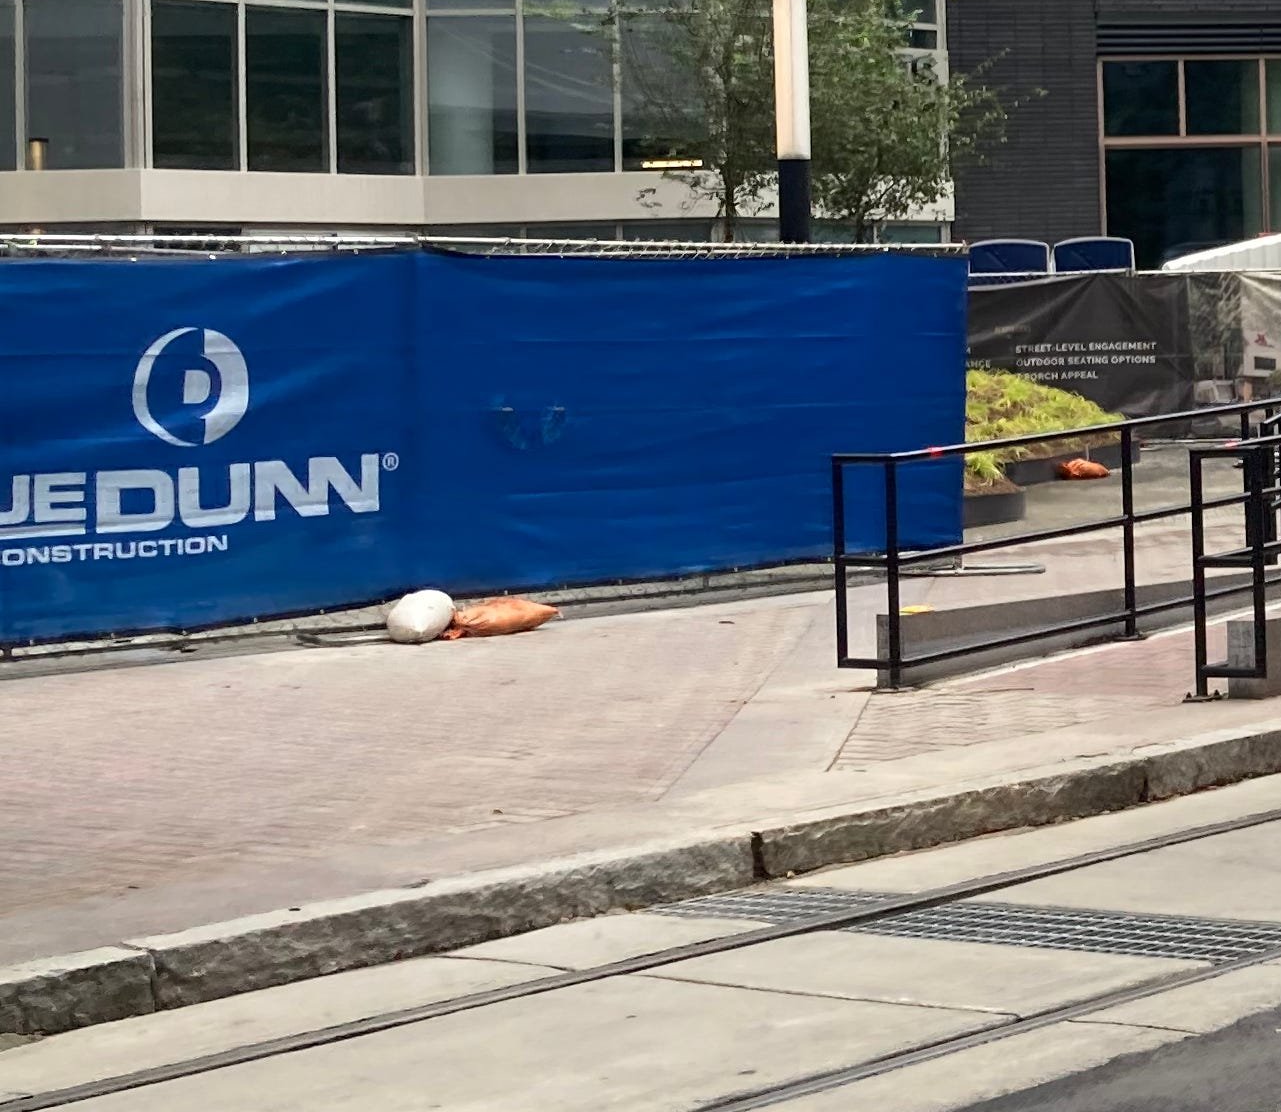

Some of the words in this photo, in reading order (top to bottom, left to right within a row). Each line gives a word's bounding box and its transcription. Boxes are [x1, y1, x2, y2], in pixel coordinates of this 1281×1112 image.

[1088, 341, 1157, 352] ENGAGEMENT
[1016, 357, 1065, 367] OUTDOOR
[1067, 356, 1109, 366] SEATING
[1110, 354, 1156, 365] OPTIONS
[1060, 370, 1099, 381] APPEAL
[0, 534, 229, 567] ONSTRUCTION
